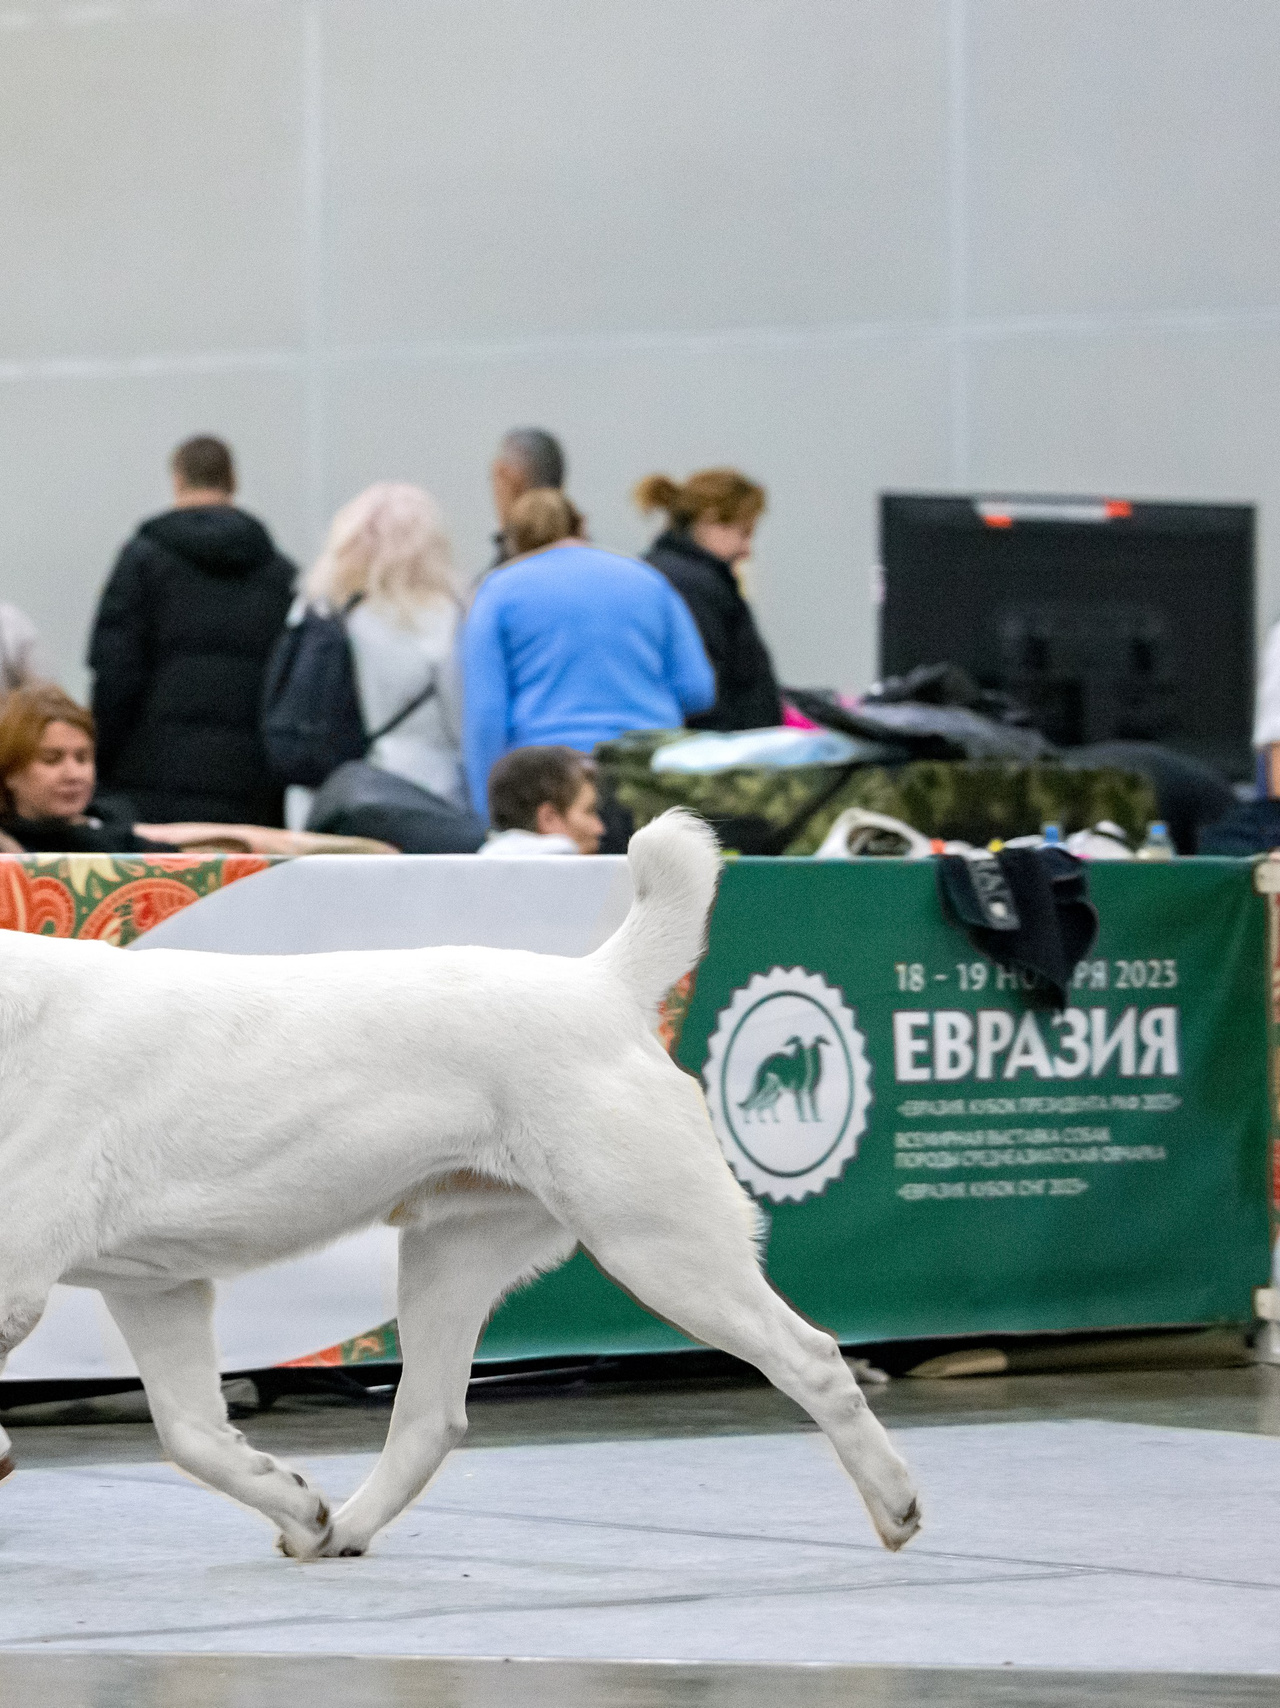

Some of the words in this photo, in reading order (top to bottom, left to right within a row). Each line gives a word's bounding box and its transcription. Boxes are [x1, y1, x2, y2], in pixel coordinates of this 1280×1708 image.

[895, 962, 925, 991] 18
[956, 962, 988, 991] 19
[1115, 958, 1179, 989] 2023
[893, 1005, 1180, 1081] ЕВРАЗИЯ
